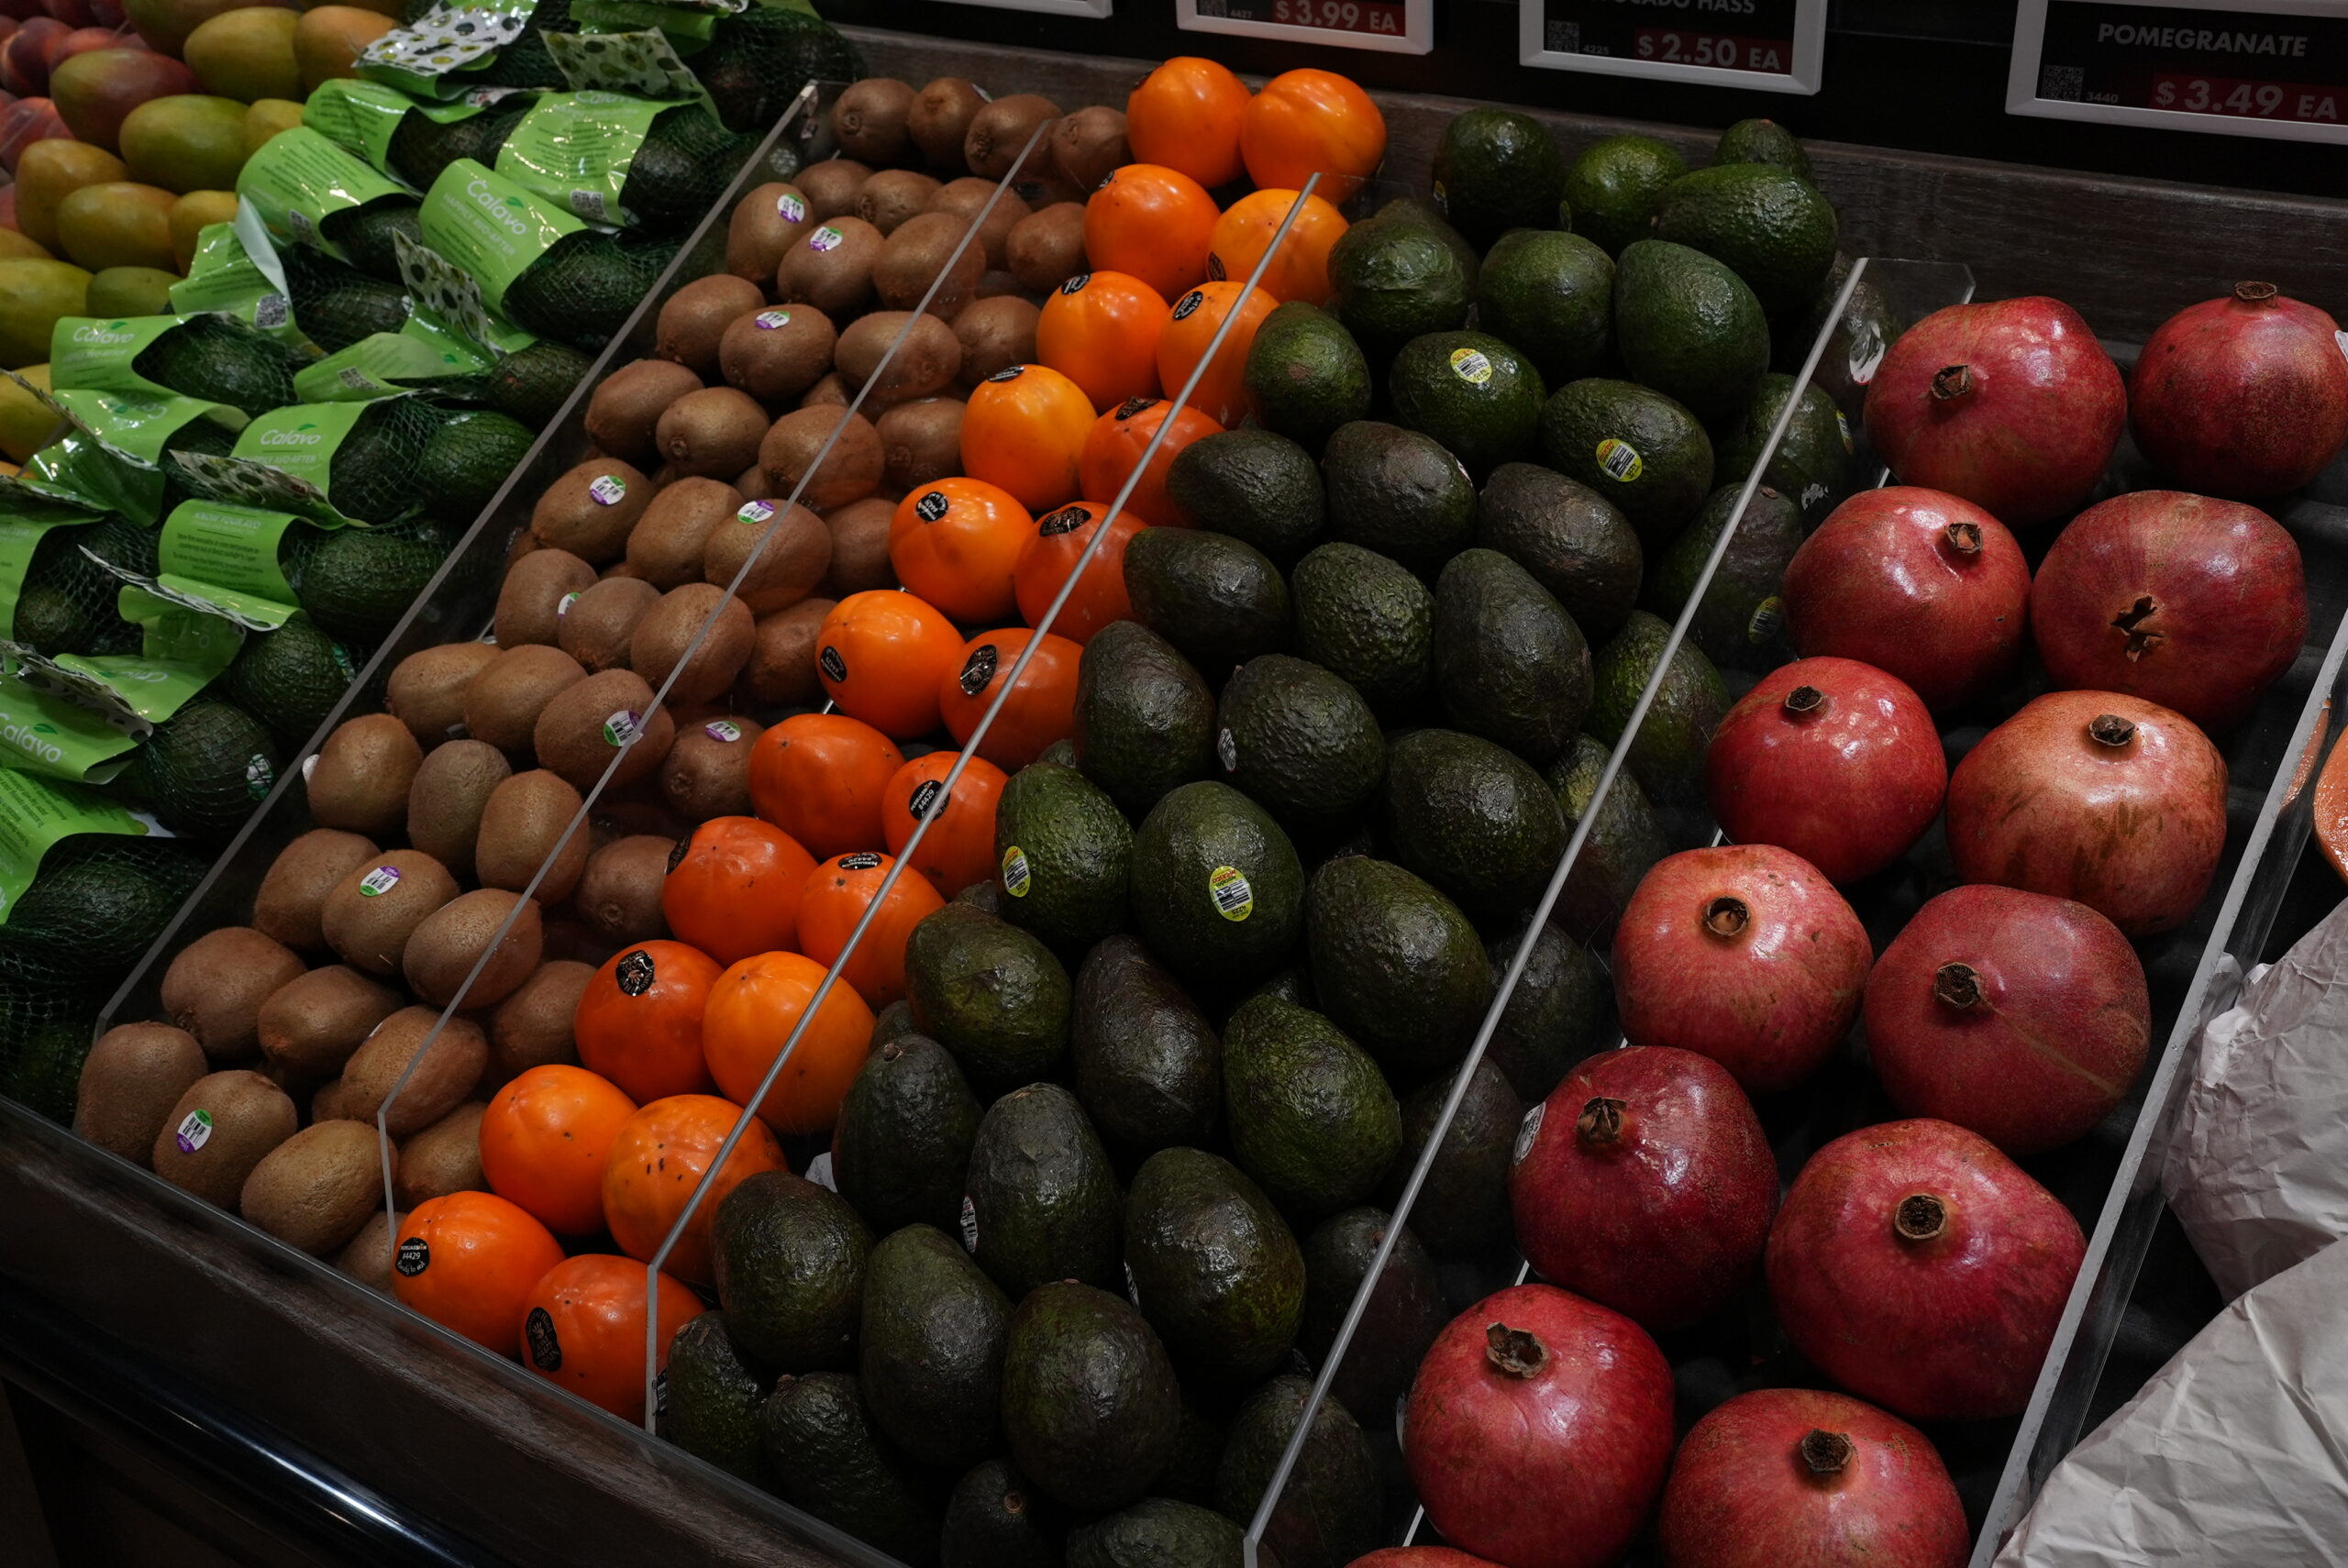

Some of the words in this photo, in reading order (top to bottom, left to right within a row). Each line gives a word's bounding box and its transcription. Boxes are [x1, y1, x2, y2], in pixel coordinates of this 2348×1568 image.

[1276, 1, 1290, 22] $
[1295, 0, 1360, 29] 3.99
[1368, 11, 1397, 33] EA
[1697, 0, 1756, 15] HASS
[1582, 44, 1611, 55] 4225
[1637, 35, 1654, 58] $
[1660, 33, 1738, 68] 2.50
[1748, 48, 1781, 72] EA
[2098, 23, 2309, 58] POMEGRANATE
[2086, 91, 2120, 105] 3440
[2155, 82, 2176, 107] $
[2184, 80, 2285, 115] 3.49
[2296, 94, 2338, 121] EA
[467, 180, 527, 236] Calavo
[72, 326, 136, 345] Calavo
[260, 428, 322, 447] Calavo
